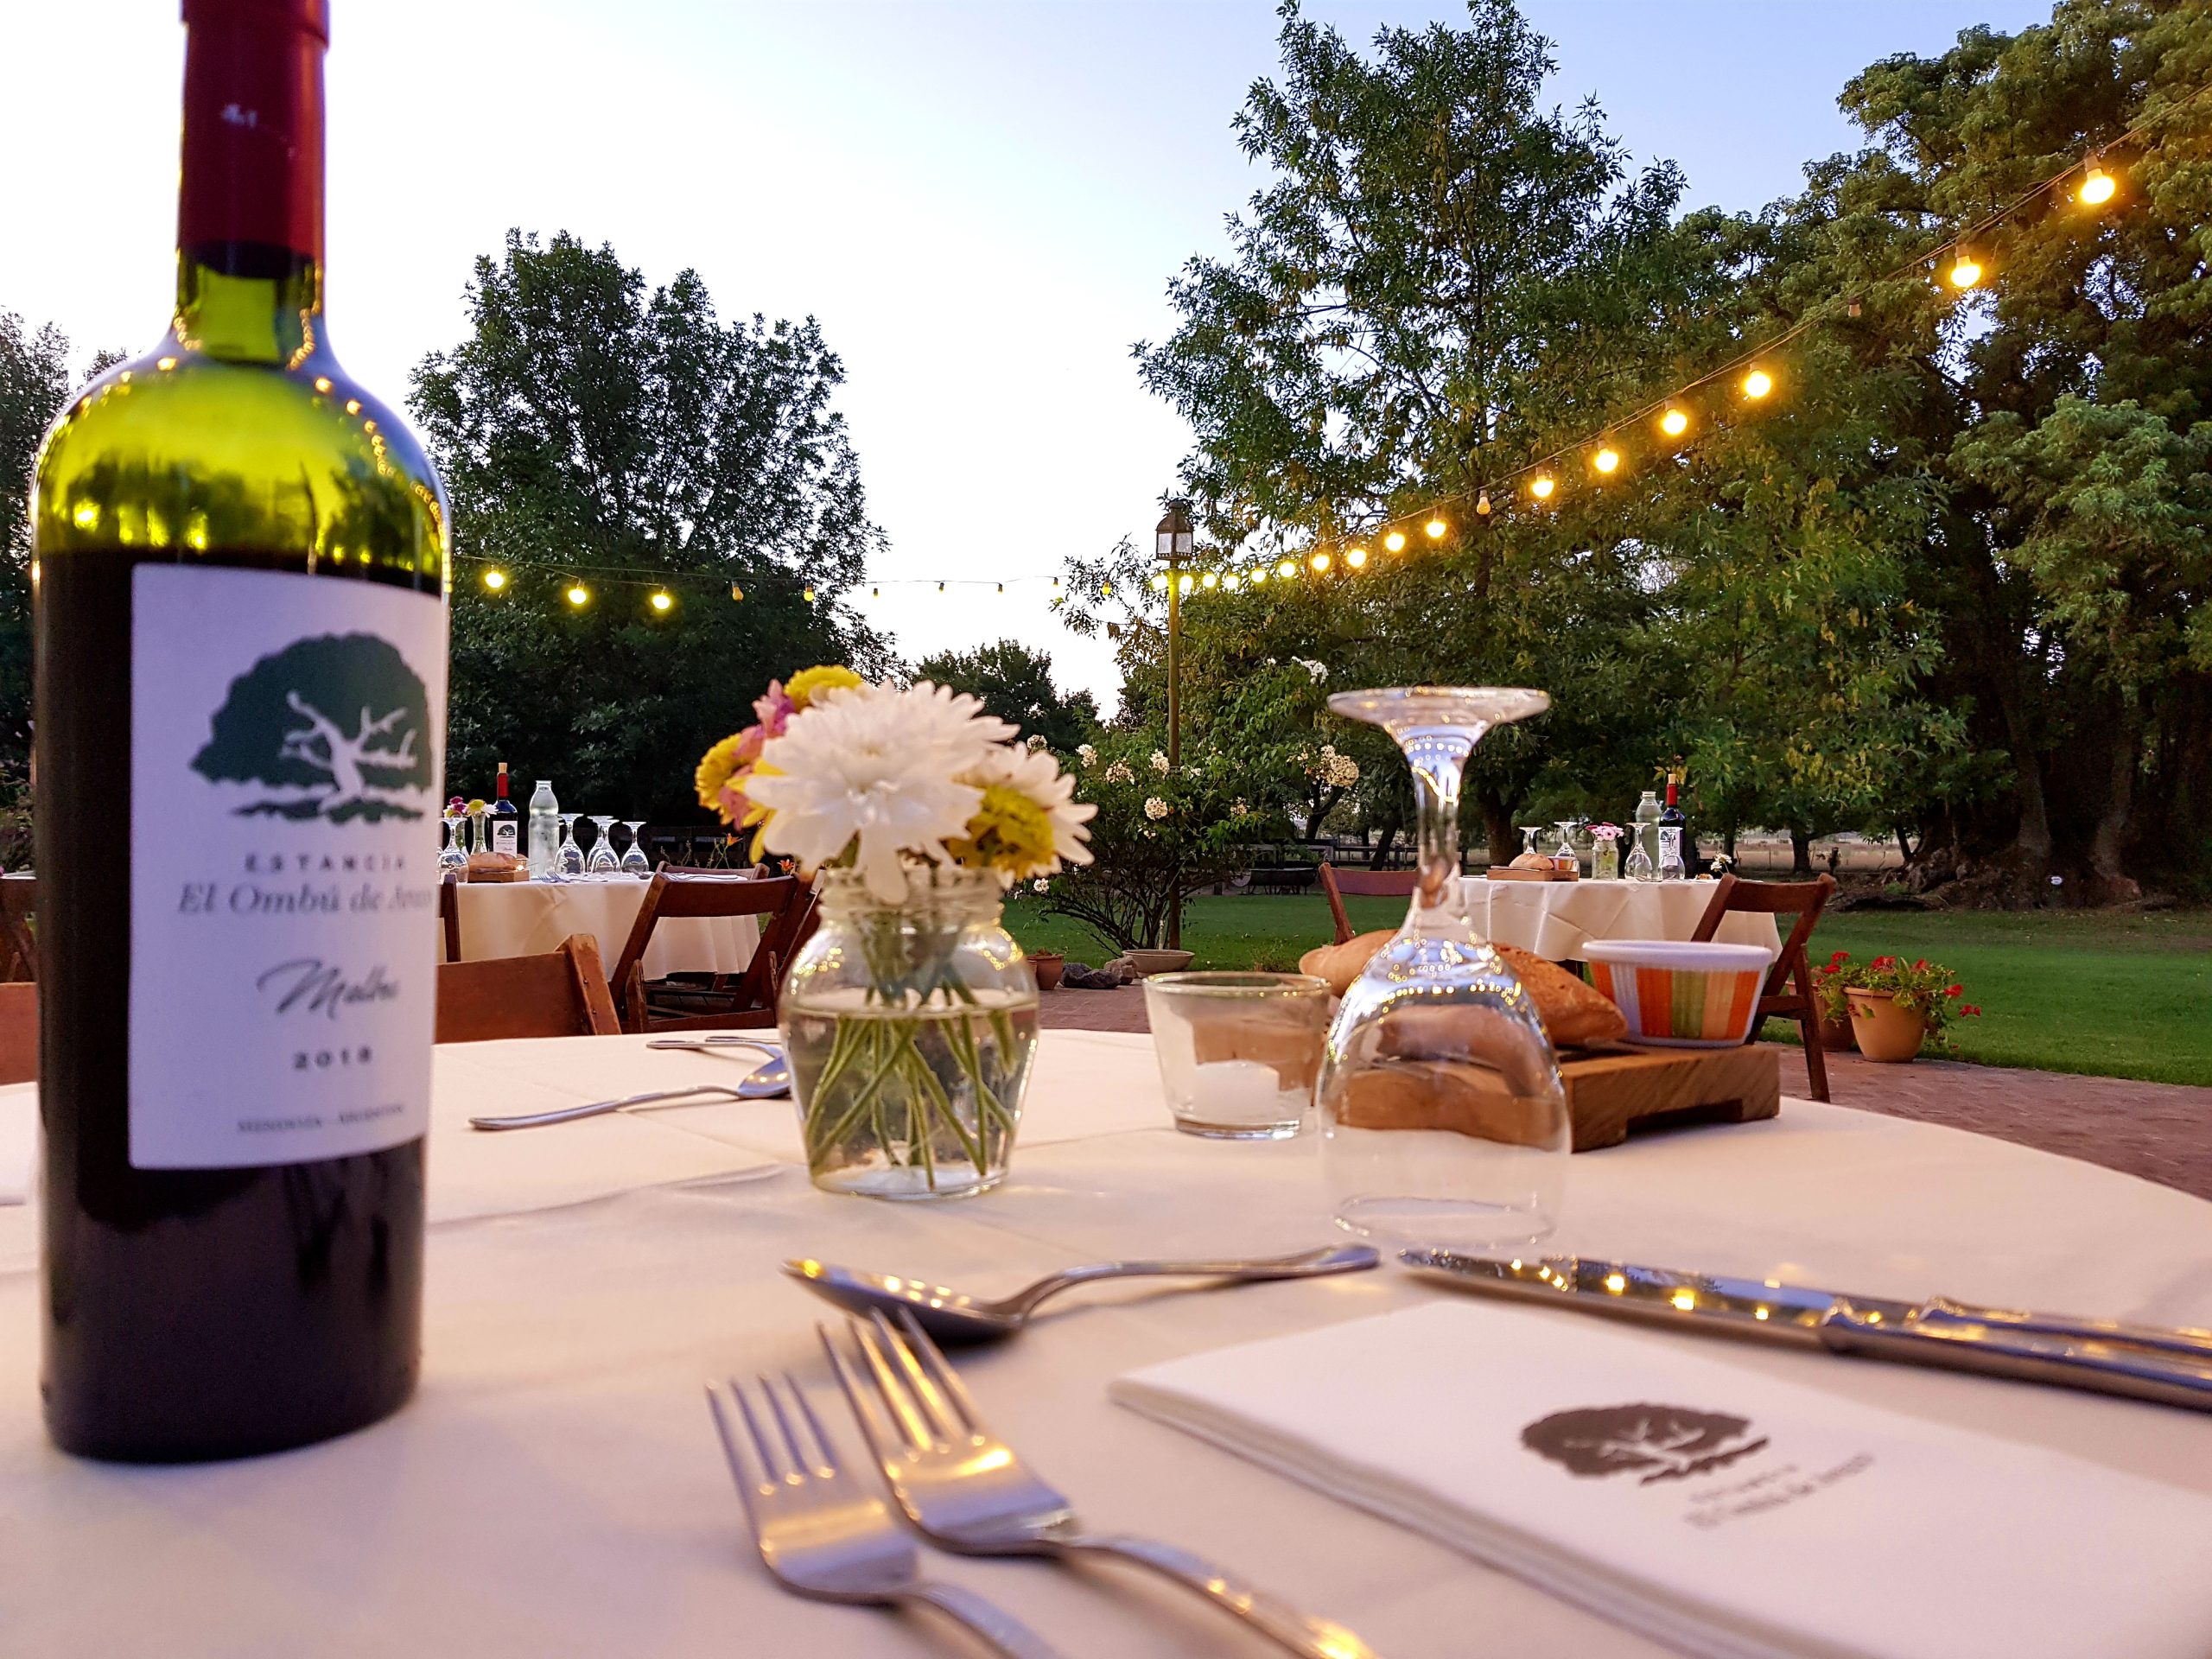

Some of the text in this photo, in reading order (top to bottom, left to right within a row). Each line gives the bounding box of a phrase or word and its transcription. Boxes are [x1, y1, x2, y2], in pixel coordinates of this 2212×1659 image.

[177, 882, 217, 913] El
[228, 882, 340, 912] Ombú
[349, 882, 382, 912] de
[294, 1046, 372, 1071] 2018
